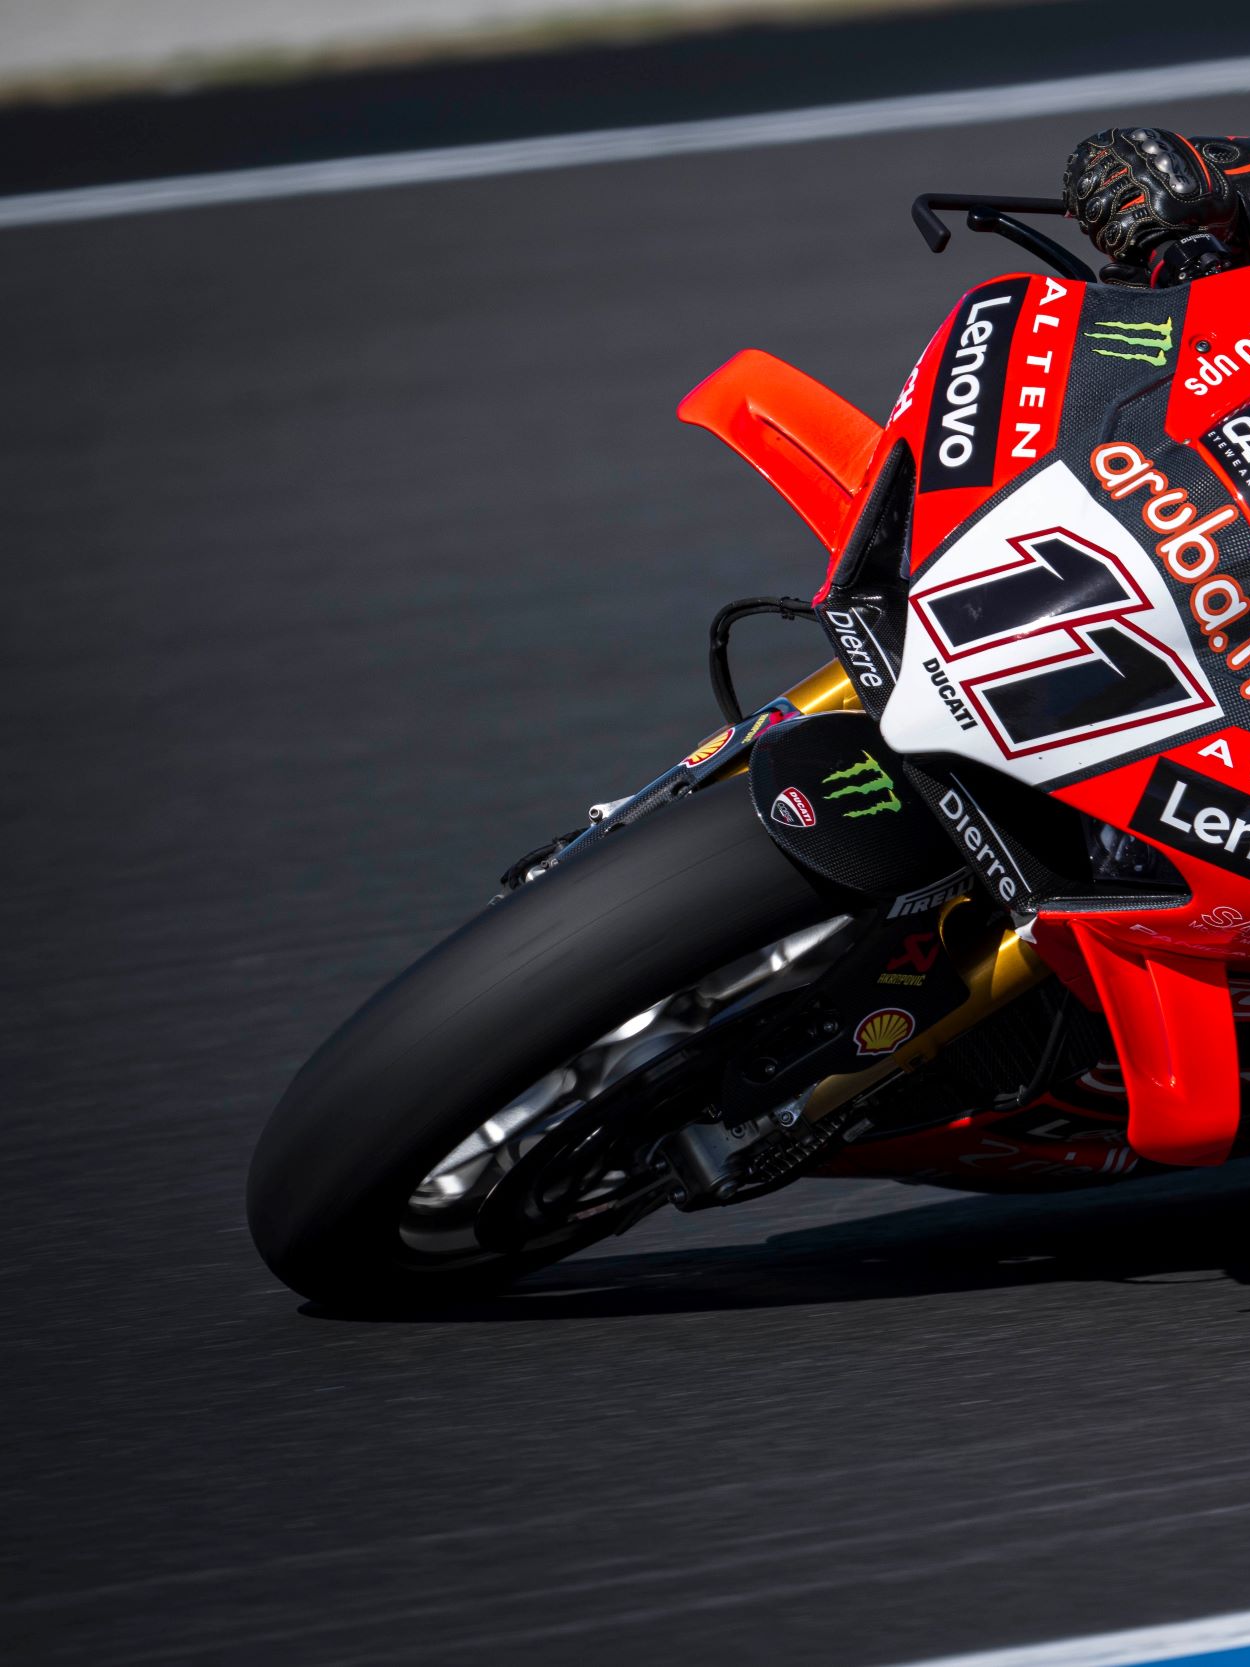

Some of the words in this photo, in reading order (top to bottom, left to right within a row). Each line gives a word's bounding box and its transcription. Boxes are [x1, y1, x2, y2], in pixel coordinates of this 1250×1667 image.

[937, 295, 1011, 468] Lenovo
[1011, 277, 1068, 459] ALTEN
[1184, 356, 1240, 396] ups
[908, 527, 1215, 760] 11
[922, 656, 979, 732] DUCATI
[789, 791, 812, 822] DUCATI
